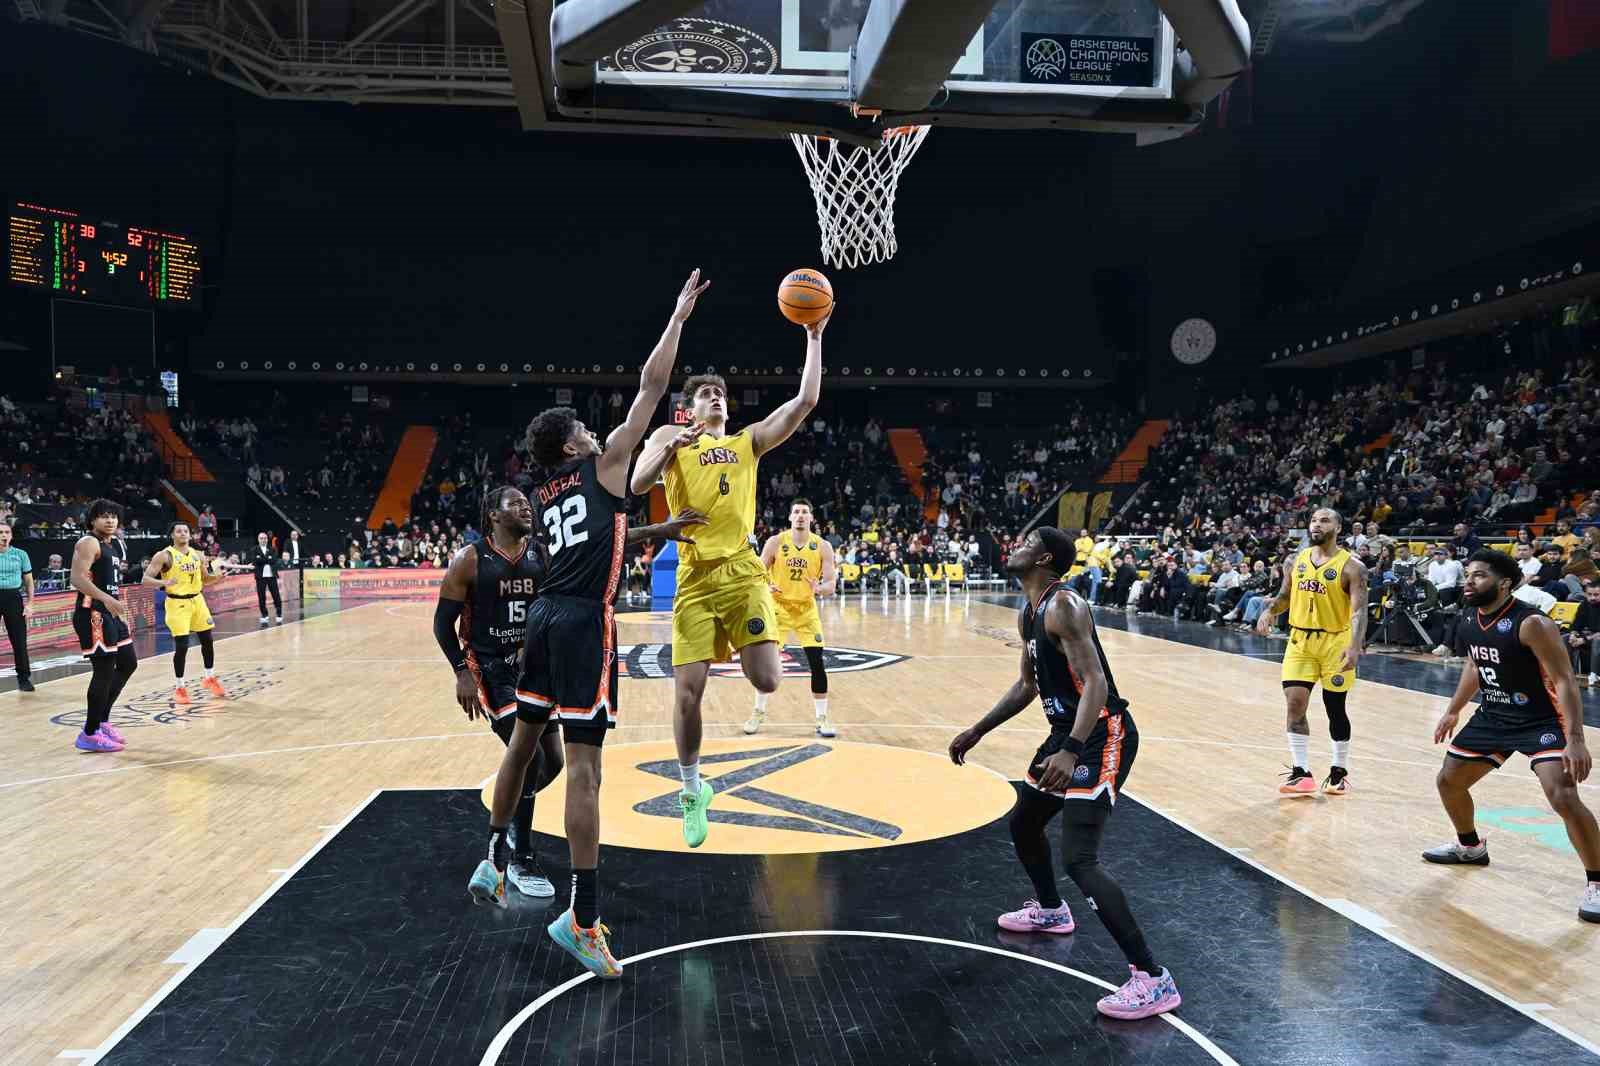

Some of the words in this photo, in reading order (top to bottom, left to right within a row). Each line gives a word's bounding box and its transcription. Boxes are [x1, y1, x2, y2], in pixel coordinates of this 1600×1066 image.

[1070, 39, 1140, 51] BASKETBALL
[1070, 50, 1149, 63] CHAMPIONS
[1070, 61, 1113, 71] LEAGUE
[1070, 73, 1103, 82] SEASON
[1106, 75, 1112, 83] X
[80, 224, 96, 239] 38
[127, 232, 143, 247] 52
[101, 250, 128, 266] 4:52
[78, 260, 86, 272] 3
[107, 264, 115, 274] 3
[700, 447, 737, 466] MSK
[538, 472, 582, 504] DUFEAL
[719, 473, 729, 495] 6
[543, 494, 589, 556] 32
[188, 574, 195, 584] 7
[790, 569, 803, 581] 22
[499, 578, 534, 596] MSB
[1298, 579, 1328, 594] MSK
[508, 600, 526, 623] 15
[1309, 598, 1314, 613] 1
[1467, 644, 1500, 664] MSB
[1478, 666, 1500, 687] 12
